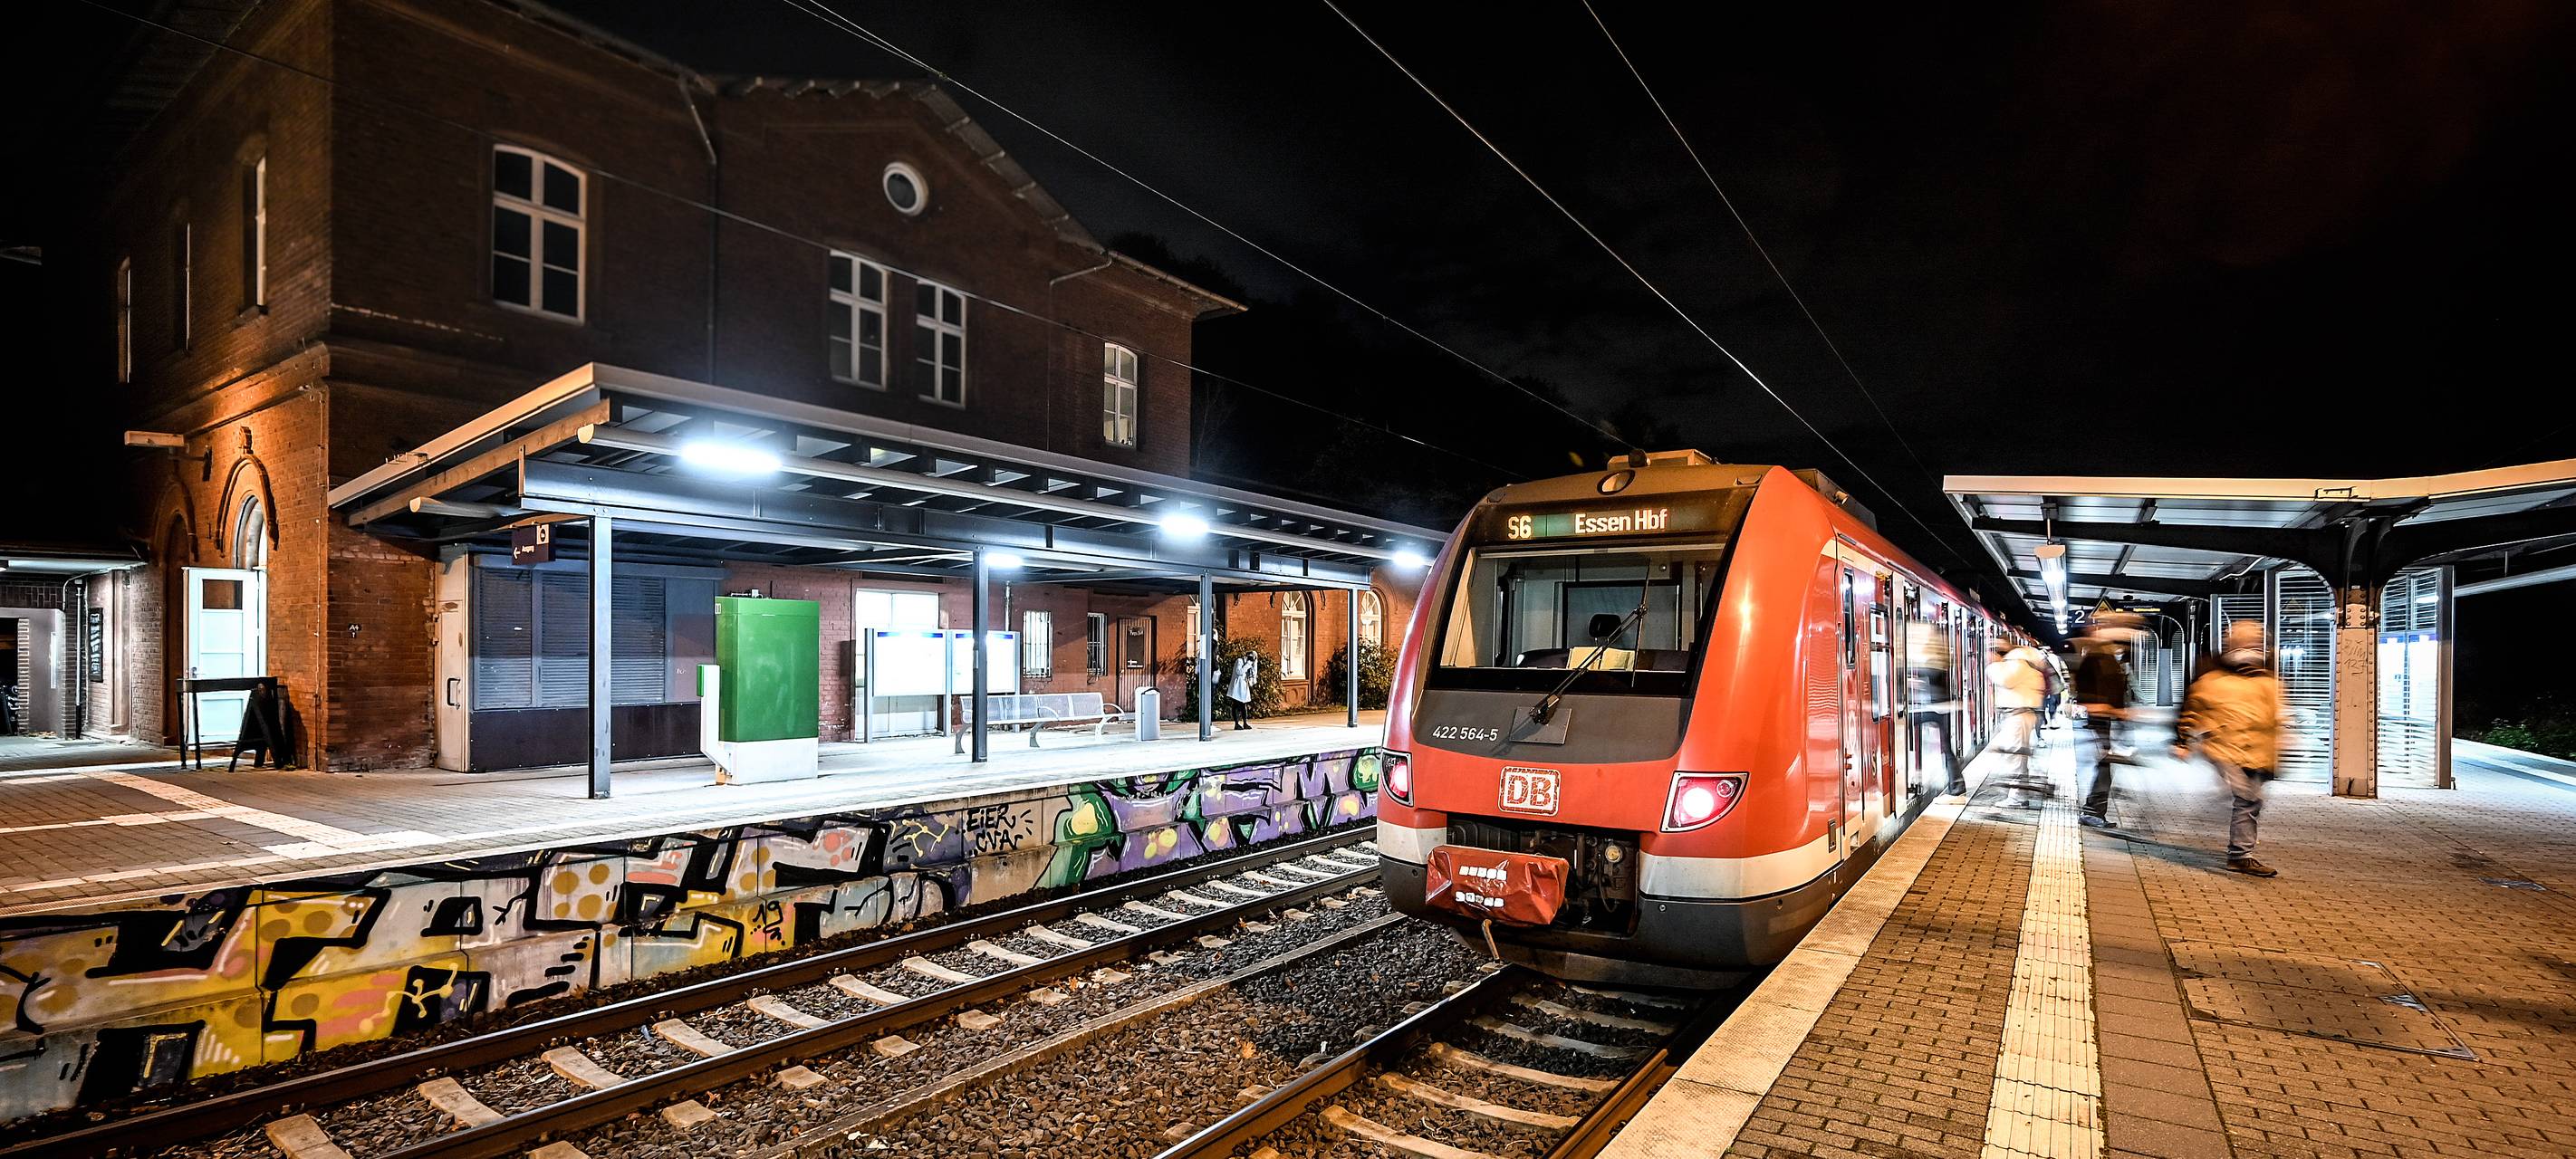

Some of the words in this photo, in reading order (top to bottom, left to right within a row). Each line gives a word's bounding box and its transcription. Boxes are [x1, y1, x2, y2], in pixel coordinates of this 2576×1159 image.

[1507, 515, 1532, 540] S6
[1574, 513, 1631, 534] Essen
[1634, 508, 1668, 531] Hbf
[2074, 609, 2085, 624] 2
[1432, 725, 1457, 739] 422
[1459, 727, 1498, 742] 564-5
[1506, 775, 1552, 807] DB
